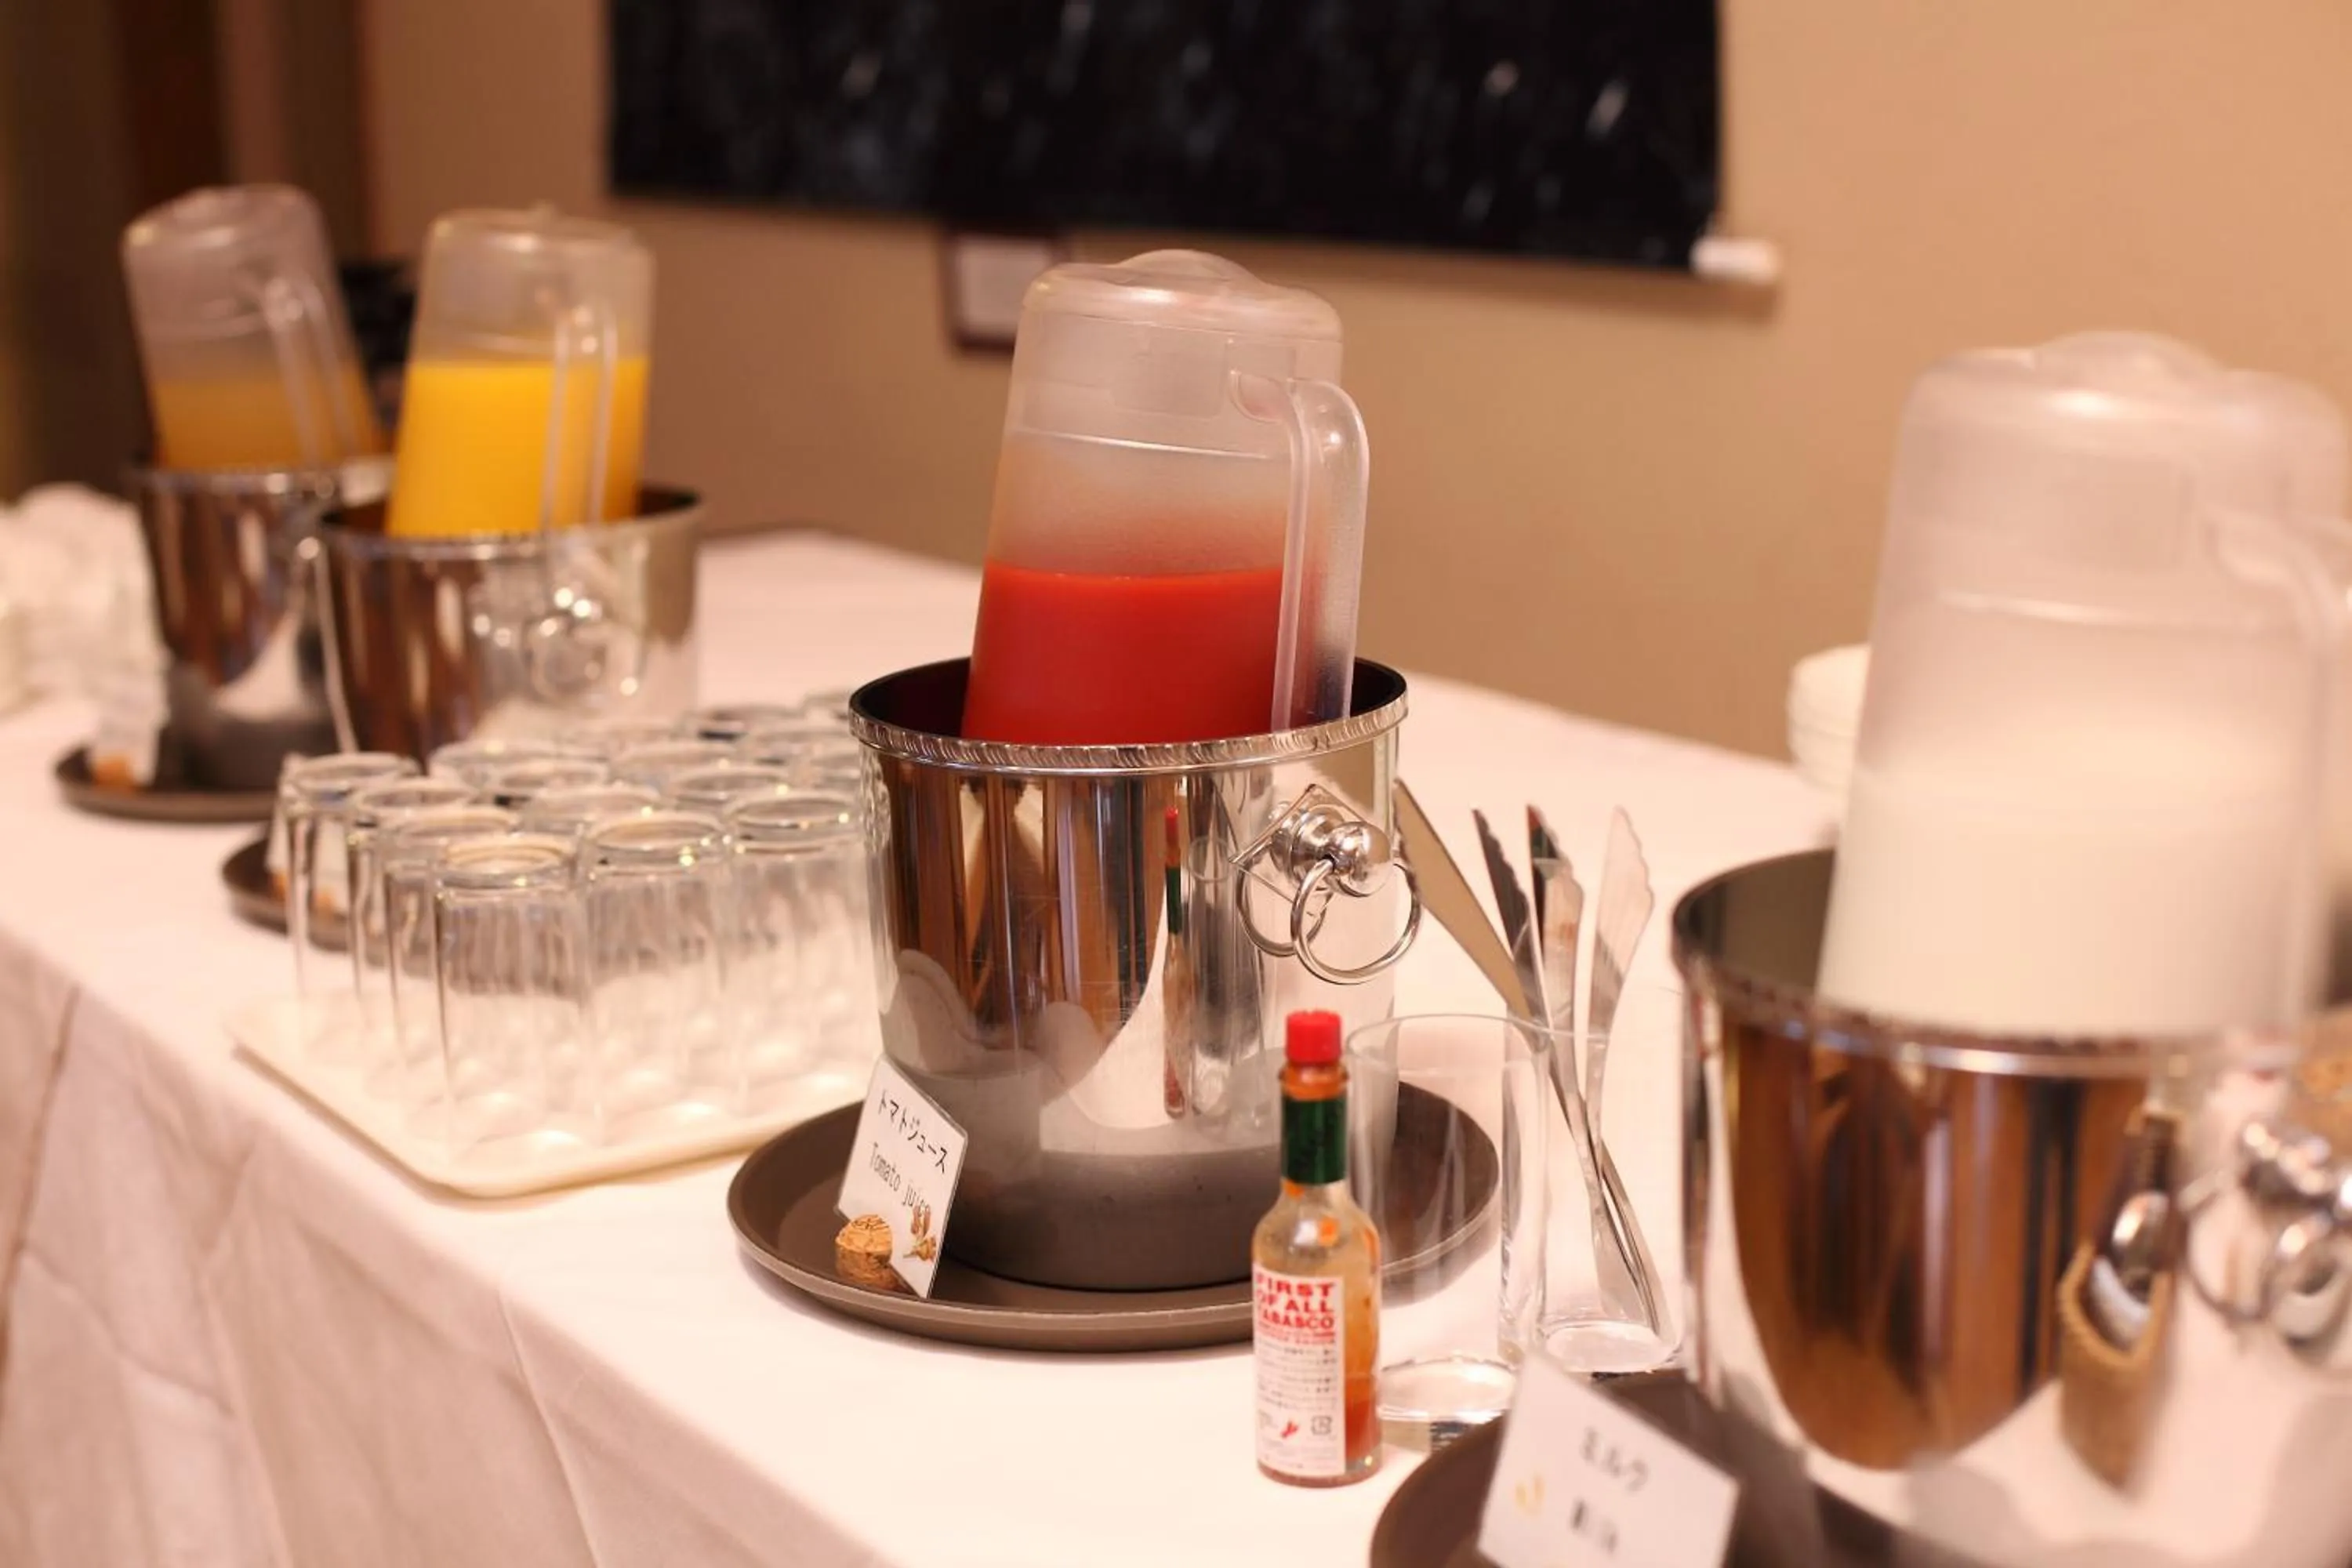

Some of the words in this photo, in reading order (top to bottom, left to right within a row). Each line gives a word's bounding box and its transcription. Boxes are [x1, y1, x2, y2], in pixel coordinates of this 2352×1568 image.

[878, 1088, 948, 1175] トマトジュース
[868, 1142, 901, 1192] Tomato
[1256, 1274, 1335, 1297] FIRST
[1257, 1305, 1334, 1329] ABASCO
[1285, 1299, 1334, 1314] ALL
